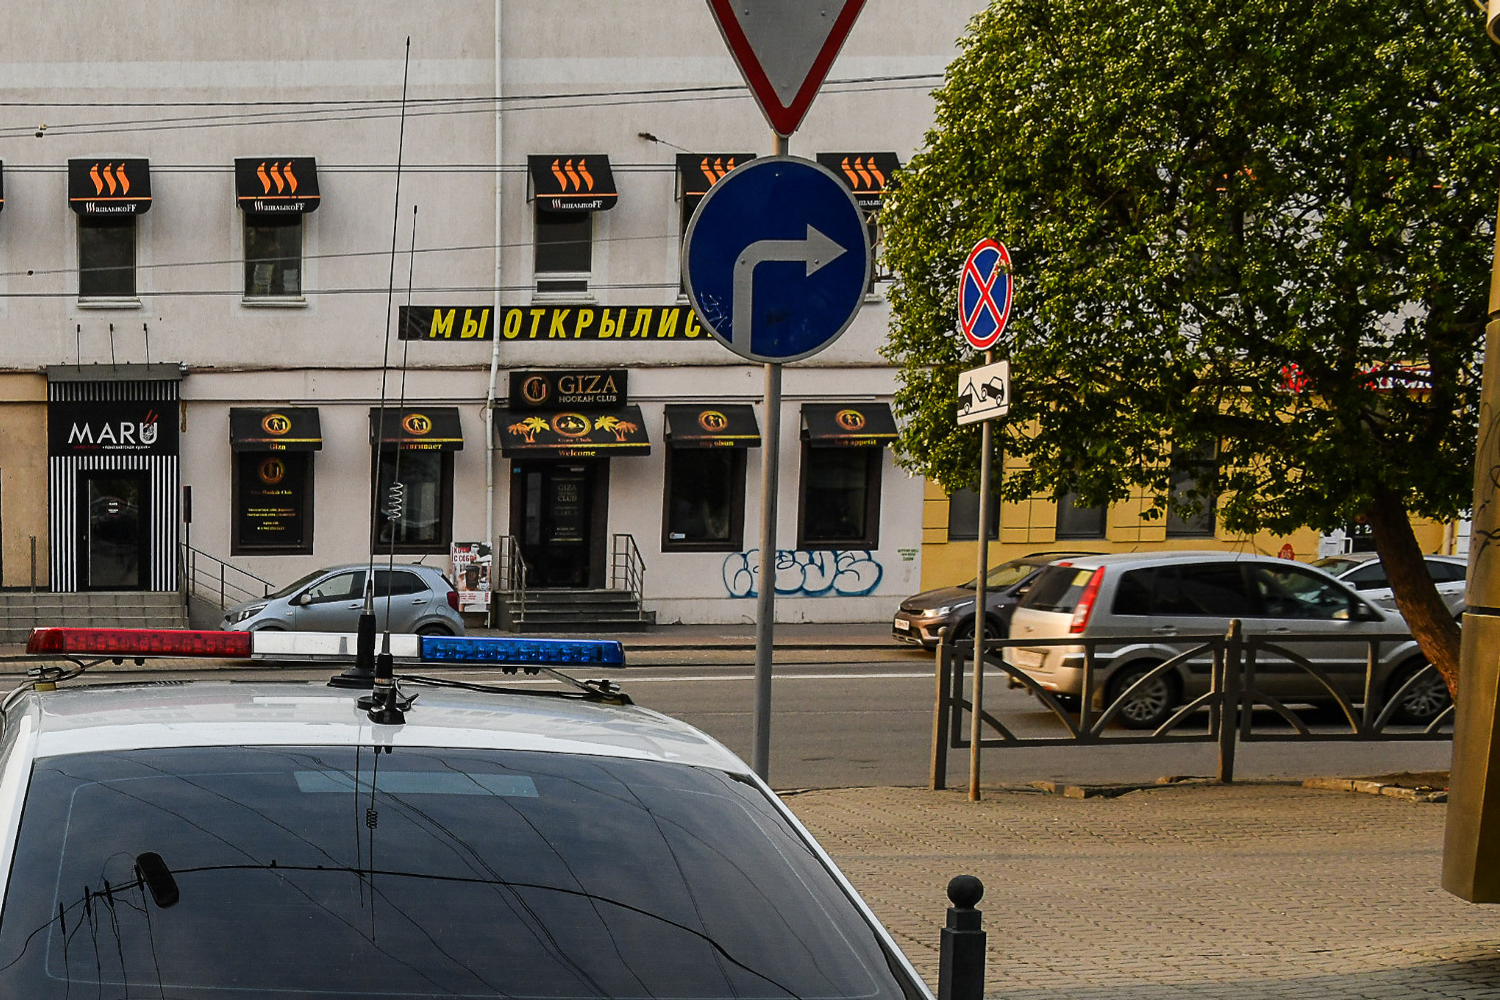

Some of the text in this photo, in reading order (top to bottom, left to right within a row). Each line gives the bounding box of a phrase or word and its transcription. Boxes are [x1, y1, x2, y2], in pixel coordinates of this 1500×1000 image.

[430, 308, 714, 338] МЫ ОТКРЫЛИС
[558, 374, 618, 394] GIZA
[558, 395, 595, 403] HOOKAH
[558, 449, 596, 457] Welcome
